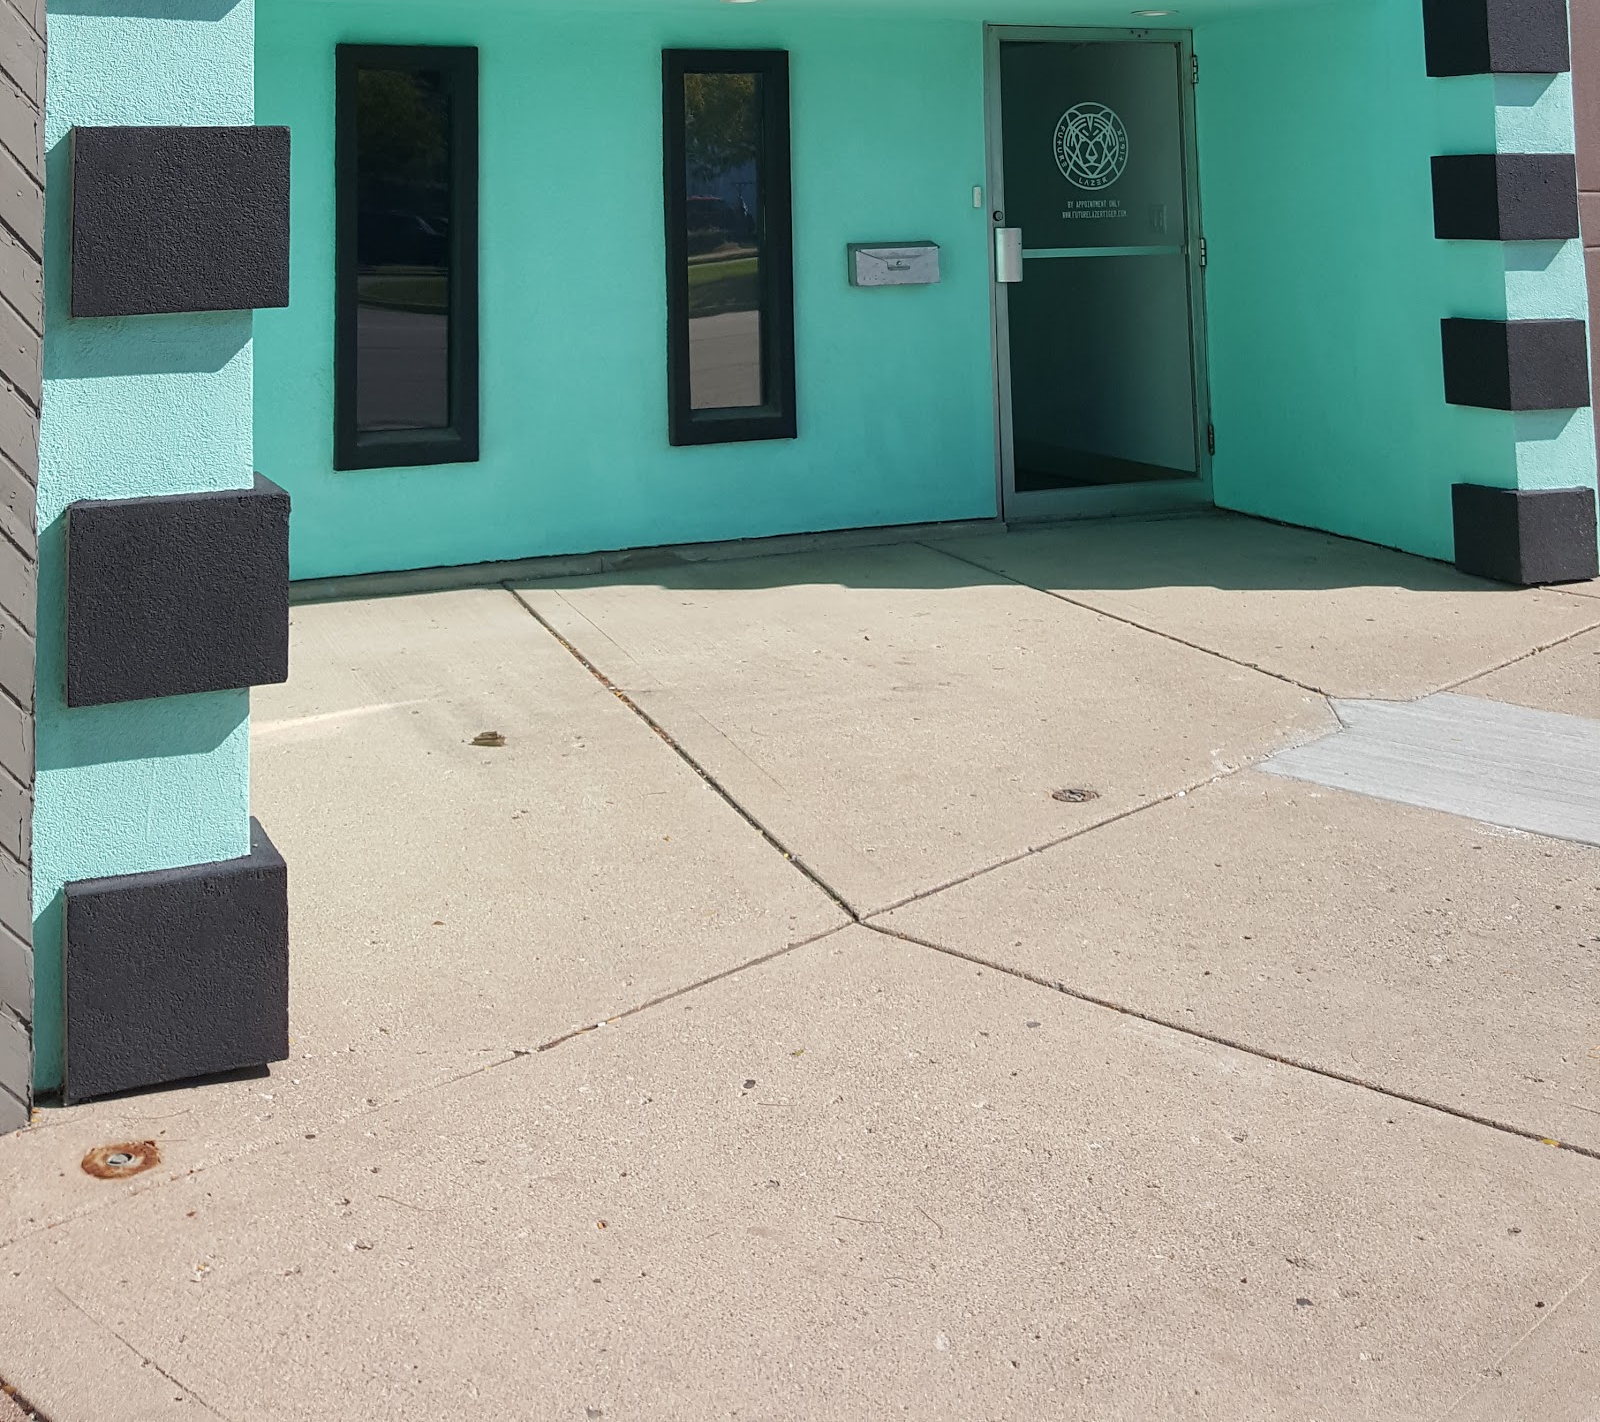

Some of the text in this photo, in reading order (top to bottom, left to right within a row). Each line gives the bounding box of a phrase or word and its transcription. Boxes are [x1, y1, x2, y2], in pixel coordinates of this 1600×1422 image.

[1057, 125, 1067, 168] FUTURE
[1079, 177, 1107, 186] LAZER
[1067, 200, 1073, 208] BY
[1076, 200, 1106, 208] APPOINTMENT
